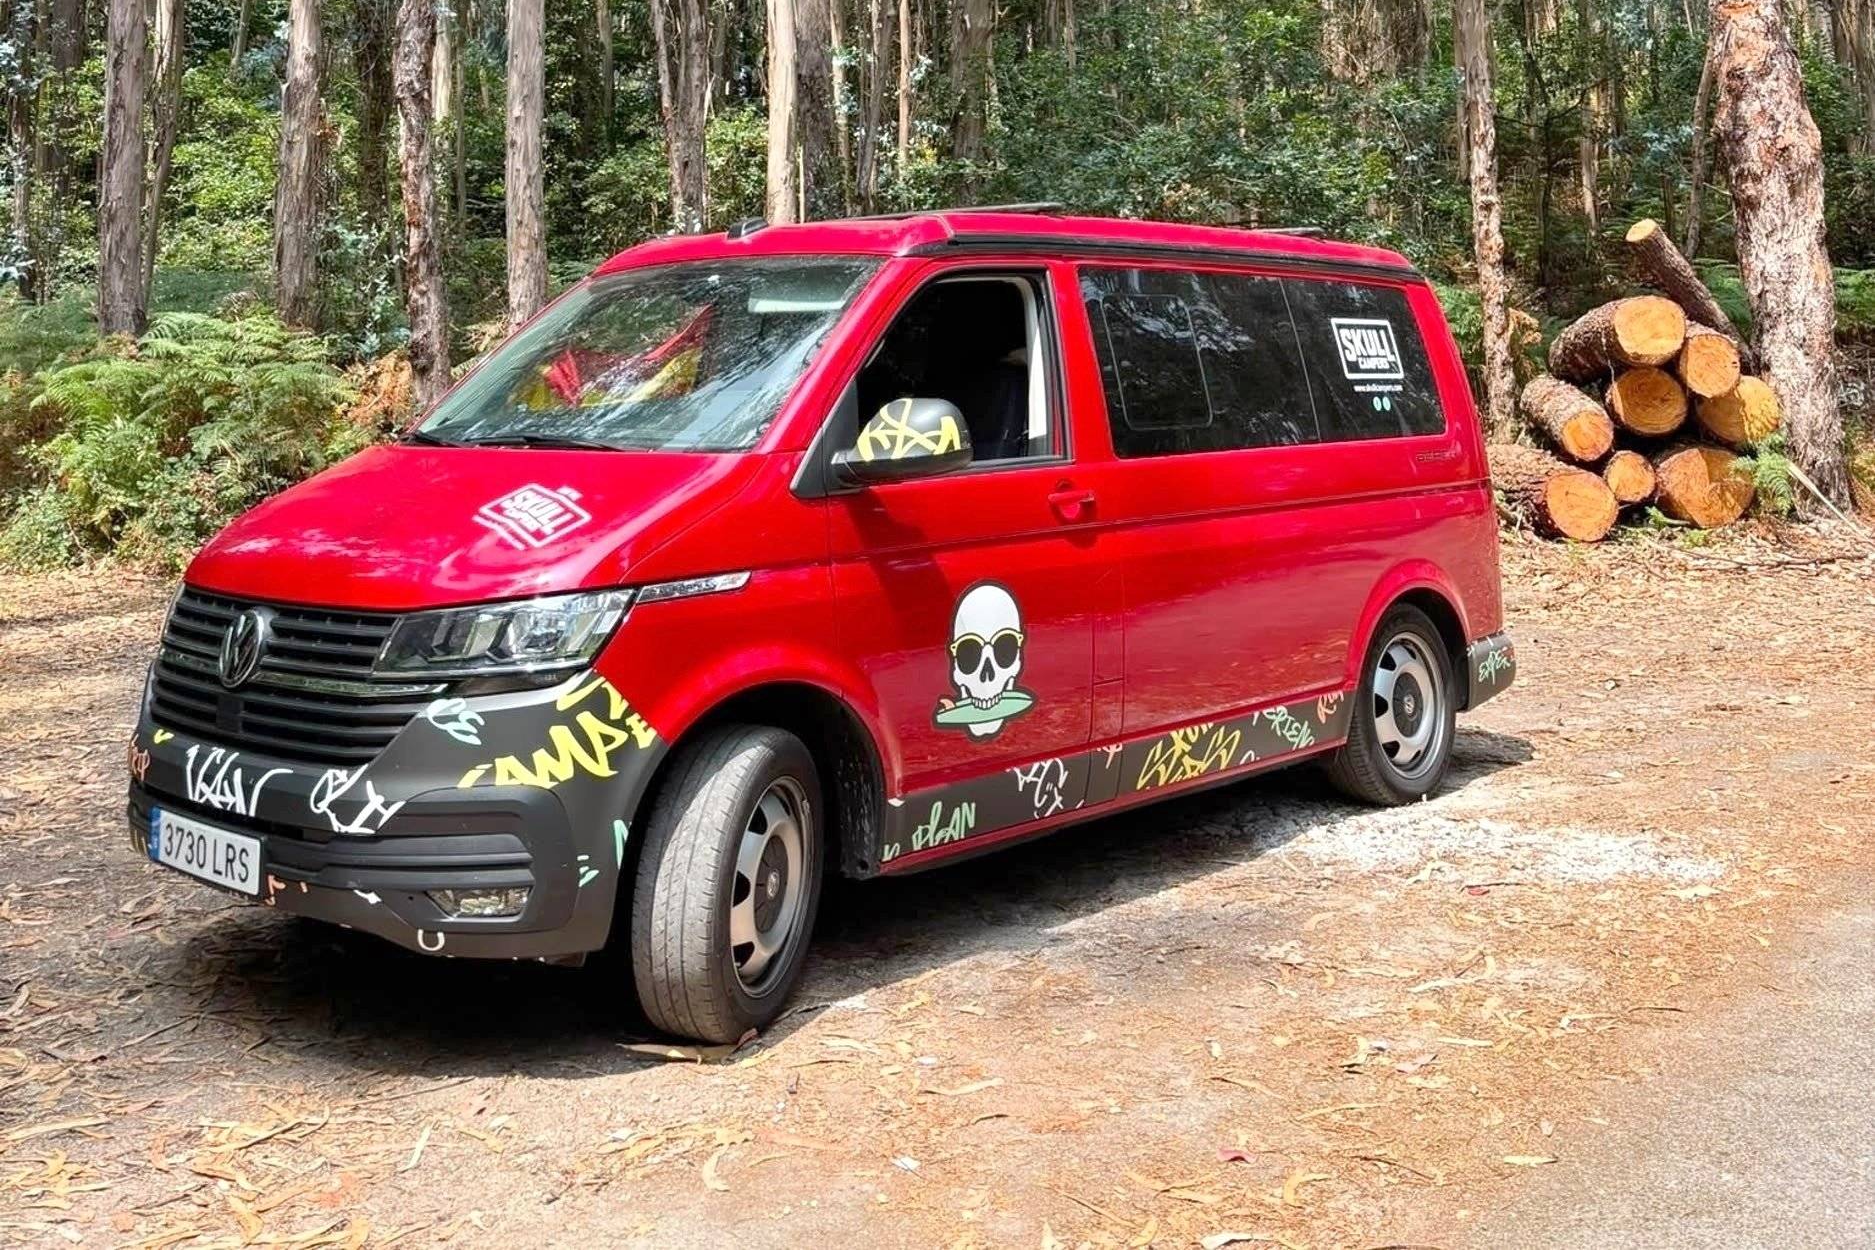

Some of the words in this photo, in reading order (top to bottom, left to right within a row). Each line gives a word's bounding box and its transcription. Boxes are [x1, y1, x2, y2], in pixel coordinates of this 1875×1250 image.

[1339, 329, 1397, 362] SKULL
[1357, 357, 1390, 369] CAMPERS
[164, 822, 207, 869] 3730
[212, 838, 249, 883] LRS
